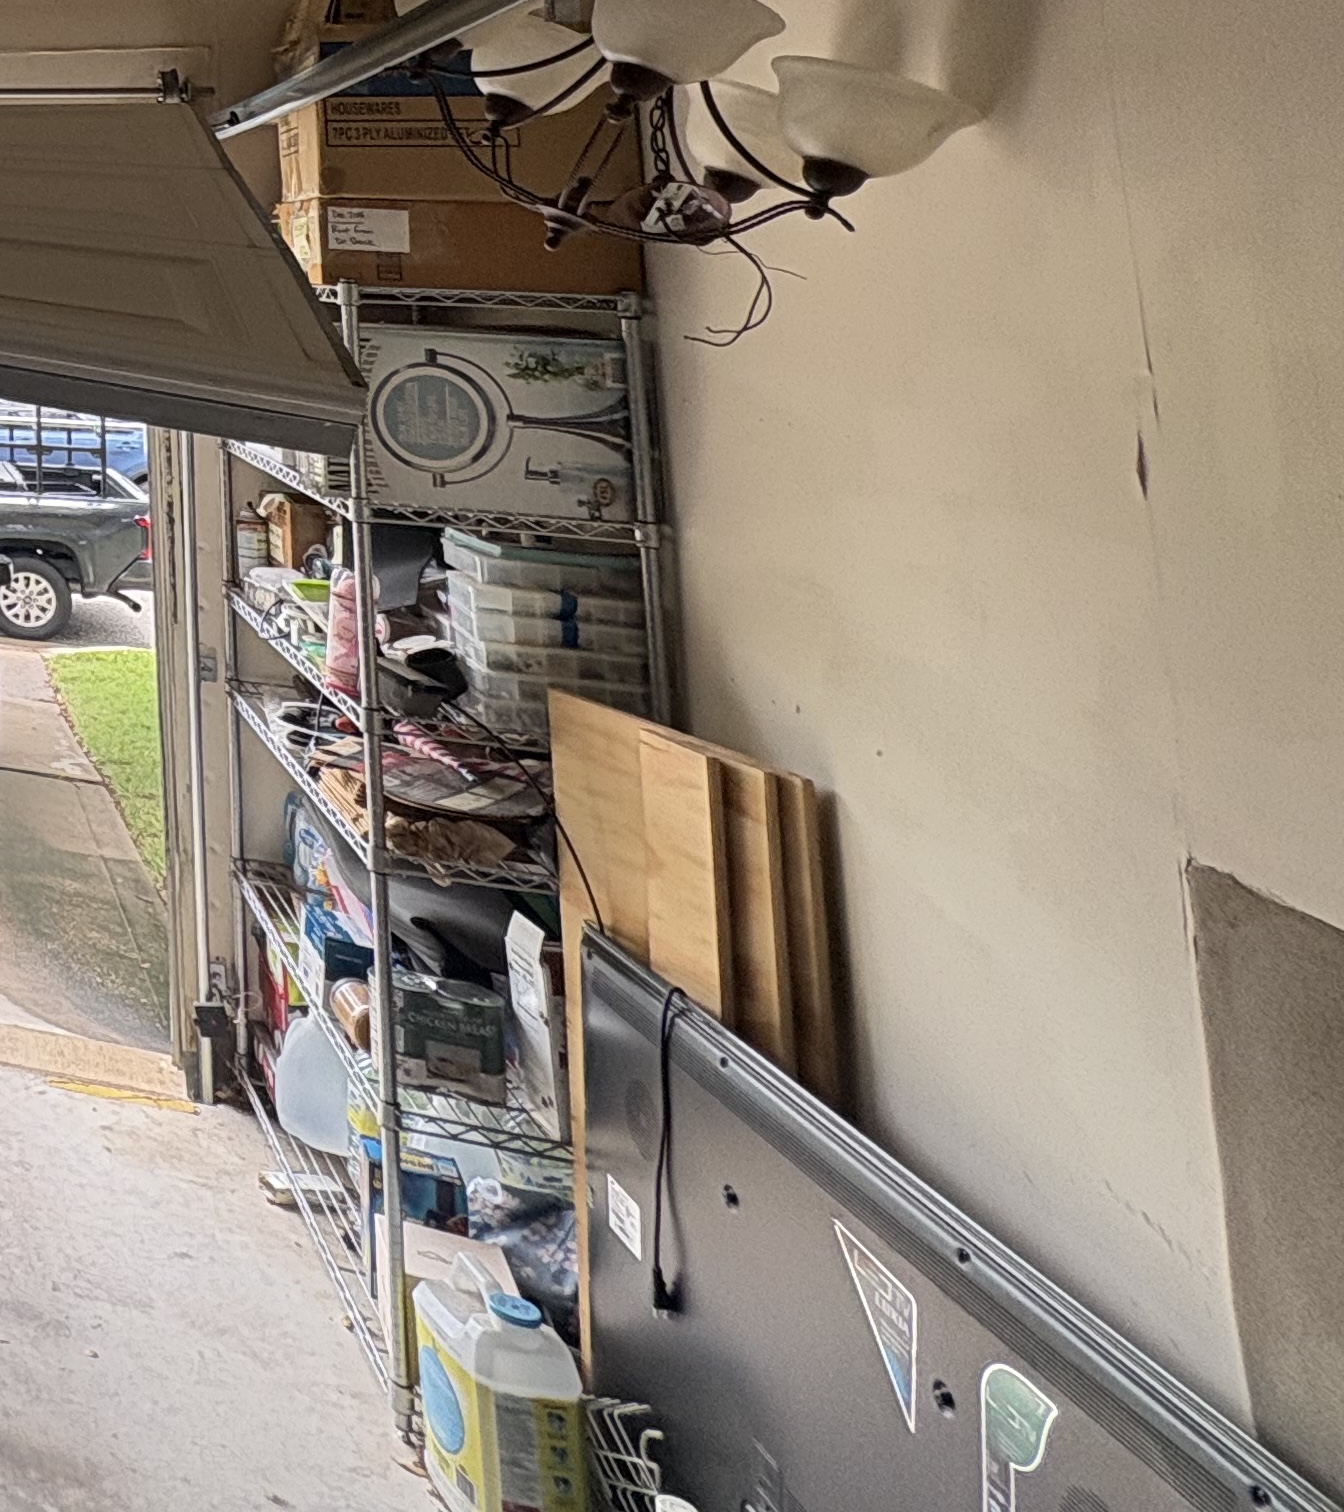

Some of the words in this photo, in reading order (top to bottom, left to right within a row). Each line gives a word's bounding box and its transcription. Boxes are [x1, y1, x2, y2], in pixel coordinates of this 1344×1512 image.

[330, 102, 401, 115] HOUSEWARES
[383, 127, 448, 141] ALUMINIZED
[407, 1010, 457, 1031] CHICKEN
